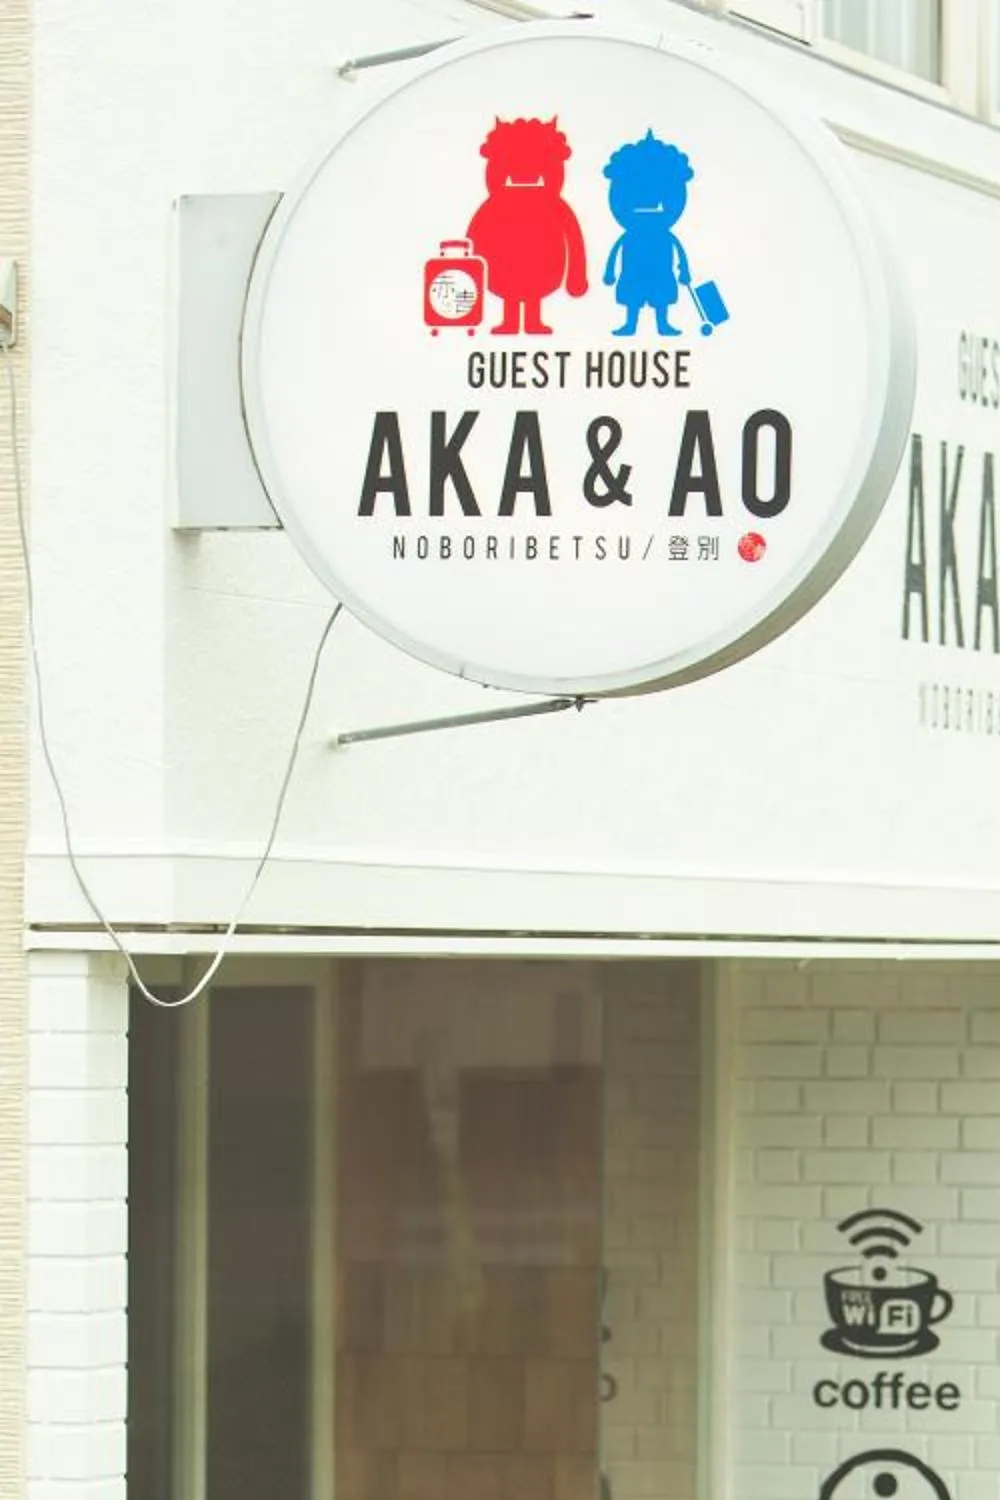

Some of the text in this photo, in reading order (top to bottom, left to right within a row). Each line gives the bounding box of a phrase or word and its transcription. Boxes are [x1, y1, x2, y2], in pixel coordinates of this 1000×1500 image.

[467, 349, 692, 389] GUEST HOUSE
[356, 407, 793, 519] AKA & AO
[901, 433, 1000, 655] AKA
[812, 1372, 961, 1411] coffee
